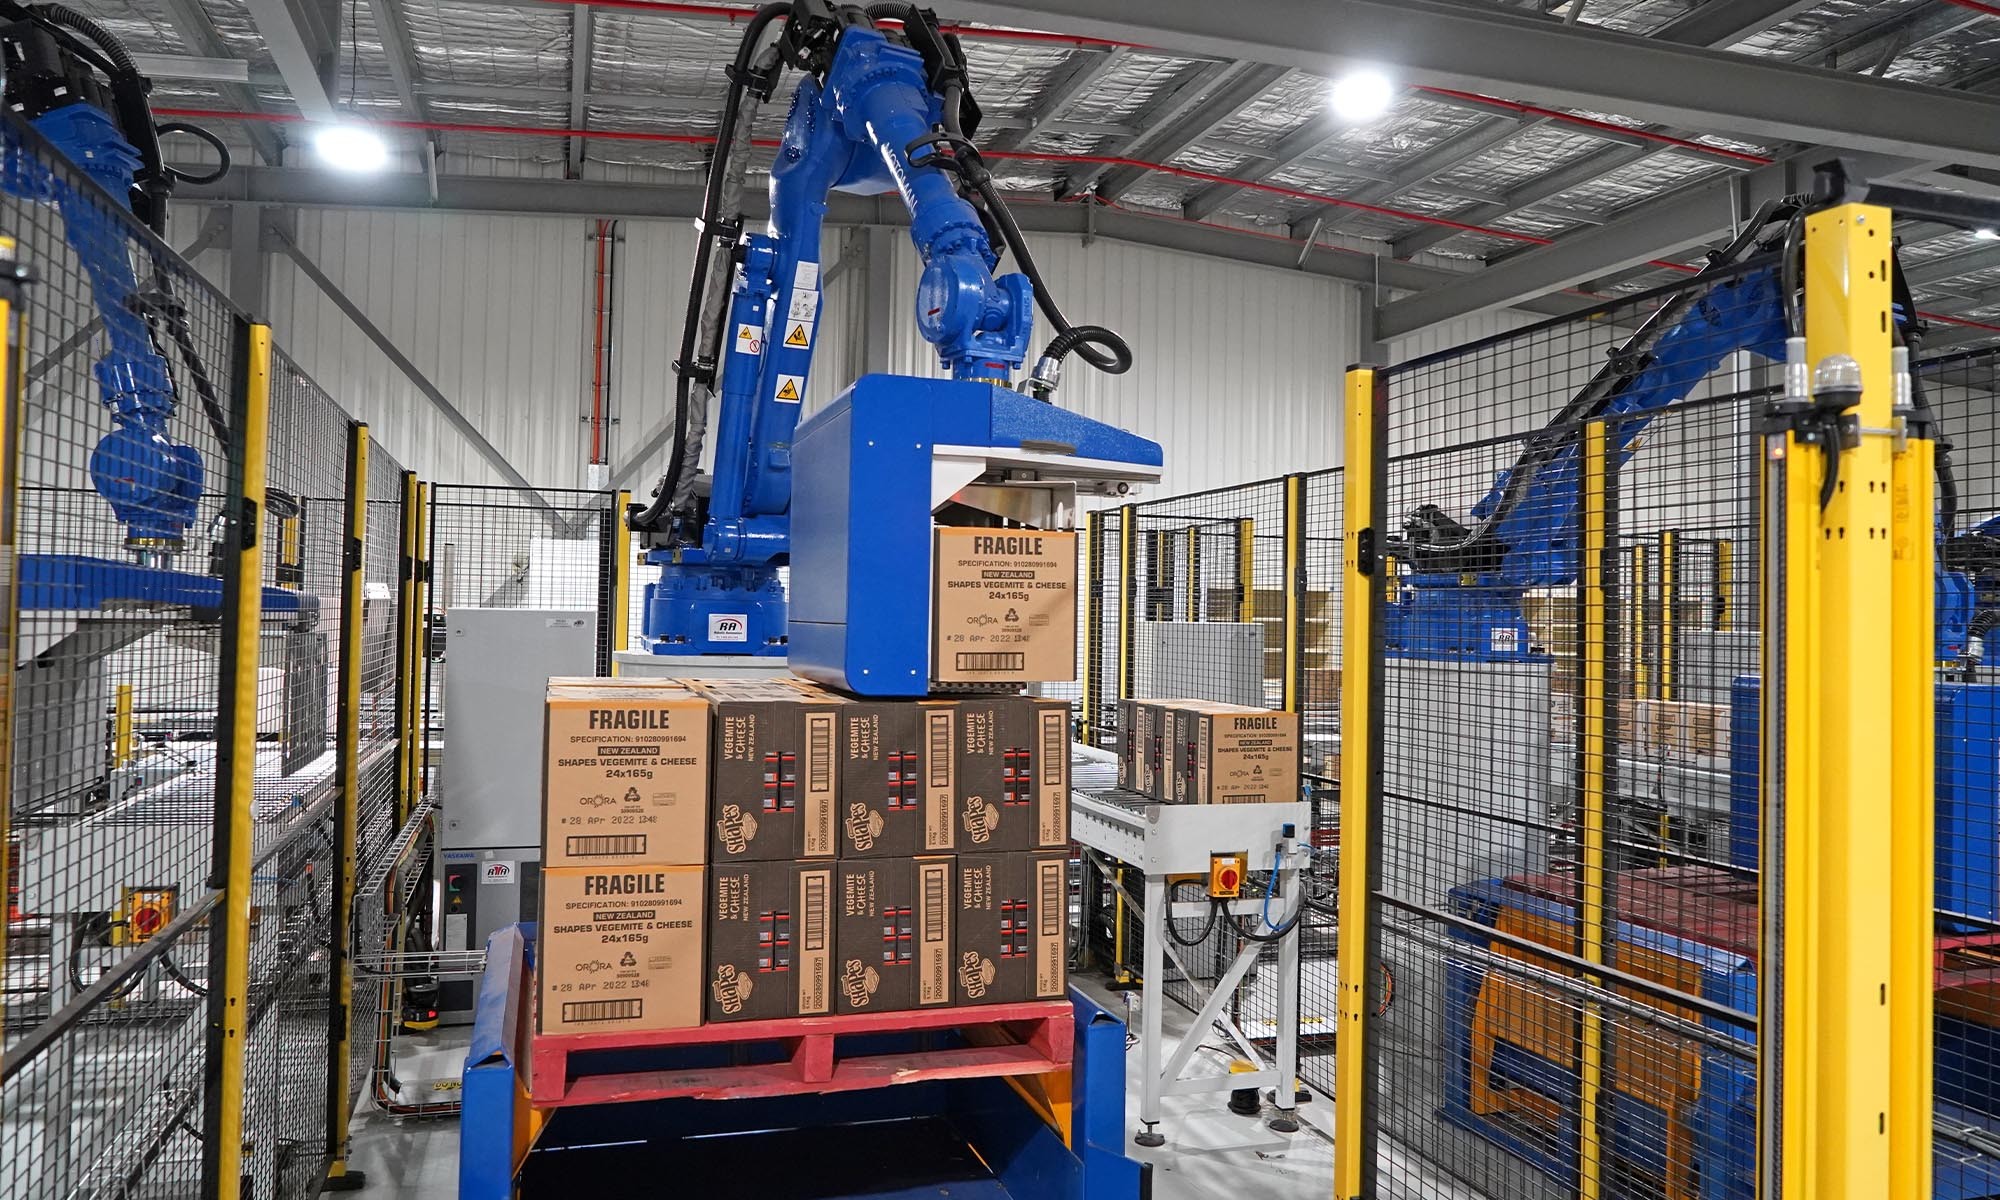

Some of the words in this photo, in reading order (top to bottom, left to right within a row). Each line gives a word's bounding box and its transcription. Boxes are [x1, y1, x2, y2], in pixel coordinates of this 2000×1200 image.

[974, 536, 1042, 555] FRAGILE
[989, 592, 1029, 601] 24x165g
[589, 710, 669, 729] FRAGILE
[977, 712, 985, 746] CHEESE
[1234, 718, 1277, 729] FRAGILE
[725, 716, 734, 760] VEGEMITE
[736, 716, 745, 752] CHEESE
[850, 717, 858, 760] VEGEMITE
[861, 717, 869, 752] CHEESE
[967, 712, 975, 754] VEGEMITE
[558, 759, 597, 767] SHAPES
[600, 758, 648, 766] VEGEMITE
[651, 758, 658, 766] &
[660, 758, 696, 766] CHEESE
[606, 770, 653, 779] 24x165g
[580, 796, 616, 807] ORORA
[612, 816, 635, 824] 2022
[820, 800, 828, 850] 200280991697
[585, 874, 664, 895] FRAGILE
[730, 876, 739, 912] CHEESE
[856, 873, 865, 909] CHEESE
[964, 868, 972, 910] VEGEMITE
[974, 868, 982, 902] CHEESE
[566, 901, 629, 909] SPECIFICATION:
[719, 876, 728, 920] VEGEMITE
[846, 873, 854, 917] VEGEMITE
[596, 912, 614, 920] NEW
[616, 911, 653, 919] ZEALAND
[554, 925, 592, 934] SHAPES
[596, 923, 643, 932] VEGEMITE
[656, 921, 692, 929] CHEESE
[601, 934, 648, 944] 24x165g
[576, 962, 612, 972] ORORA
[561, 984, 572, 992] 28
[603, 981, 626, 989] 2022
